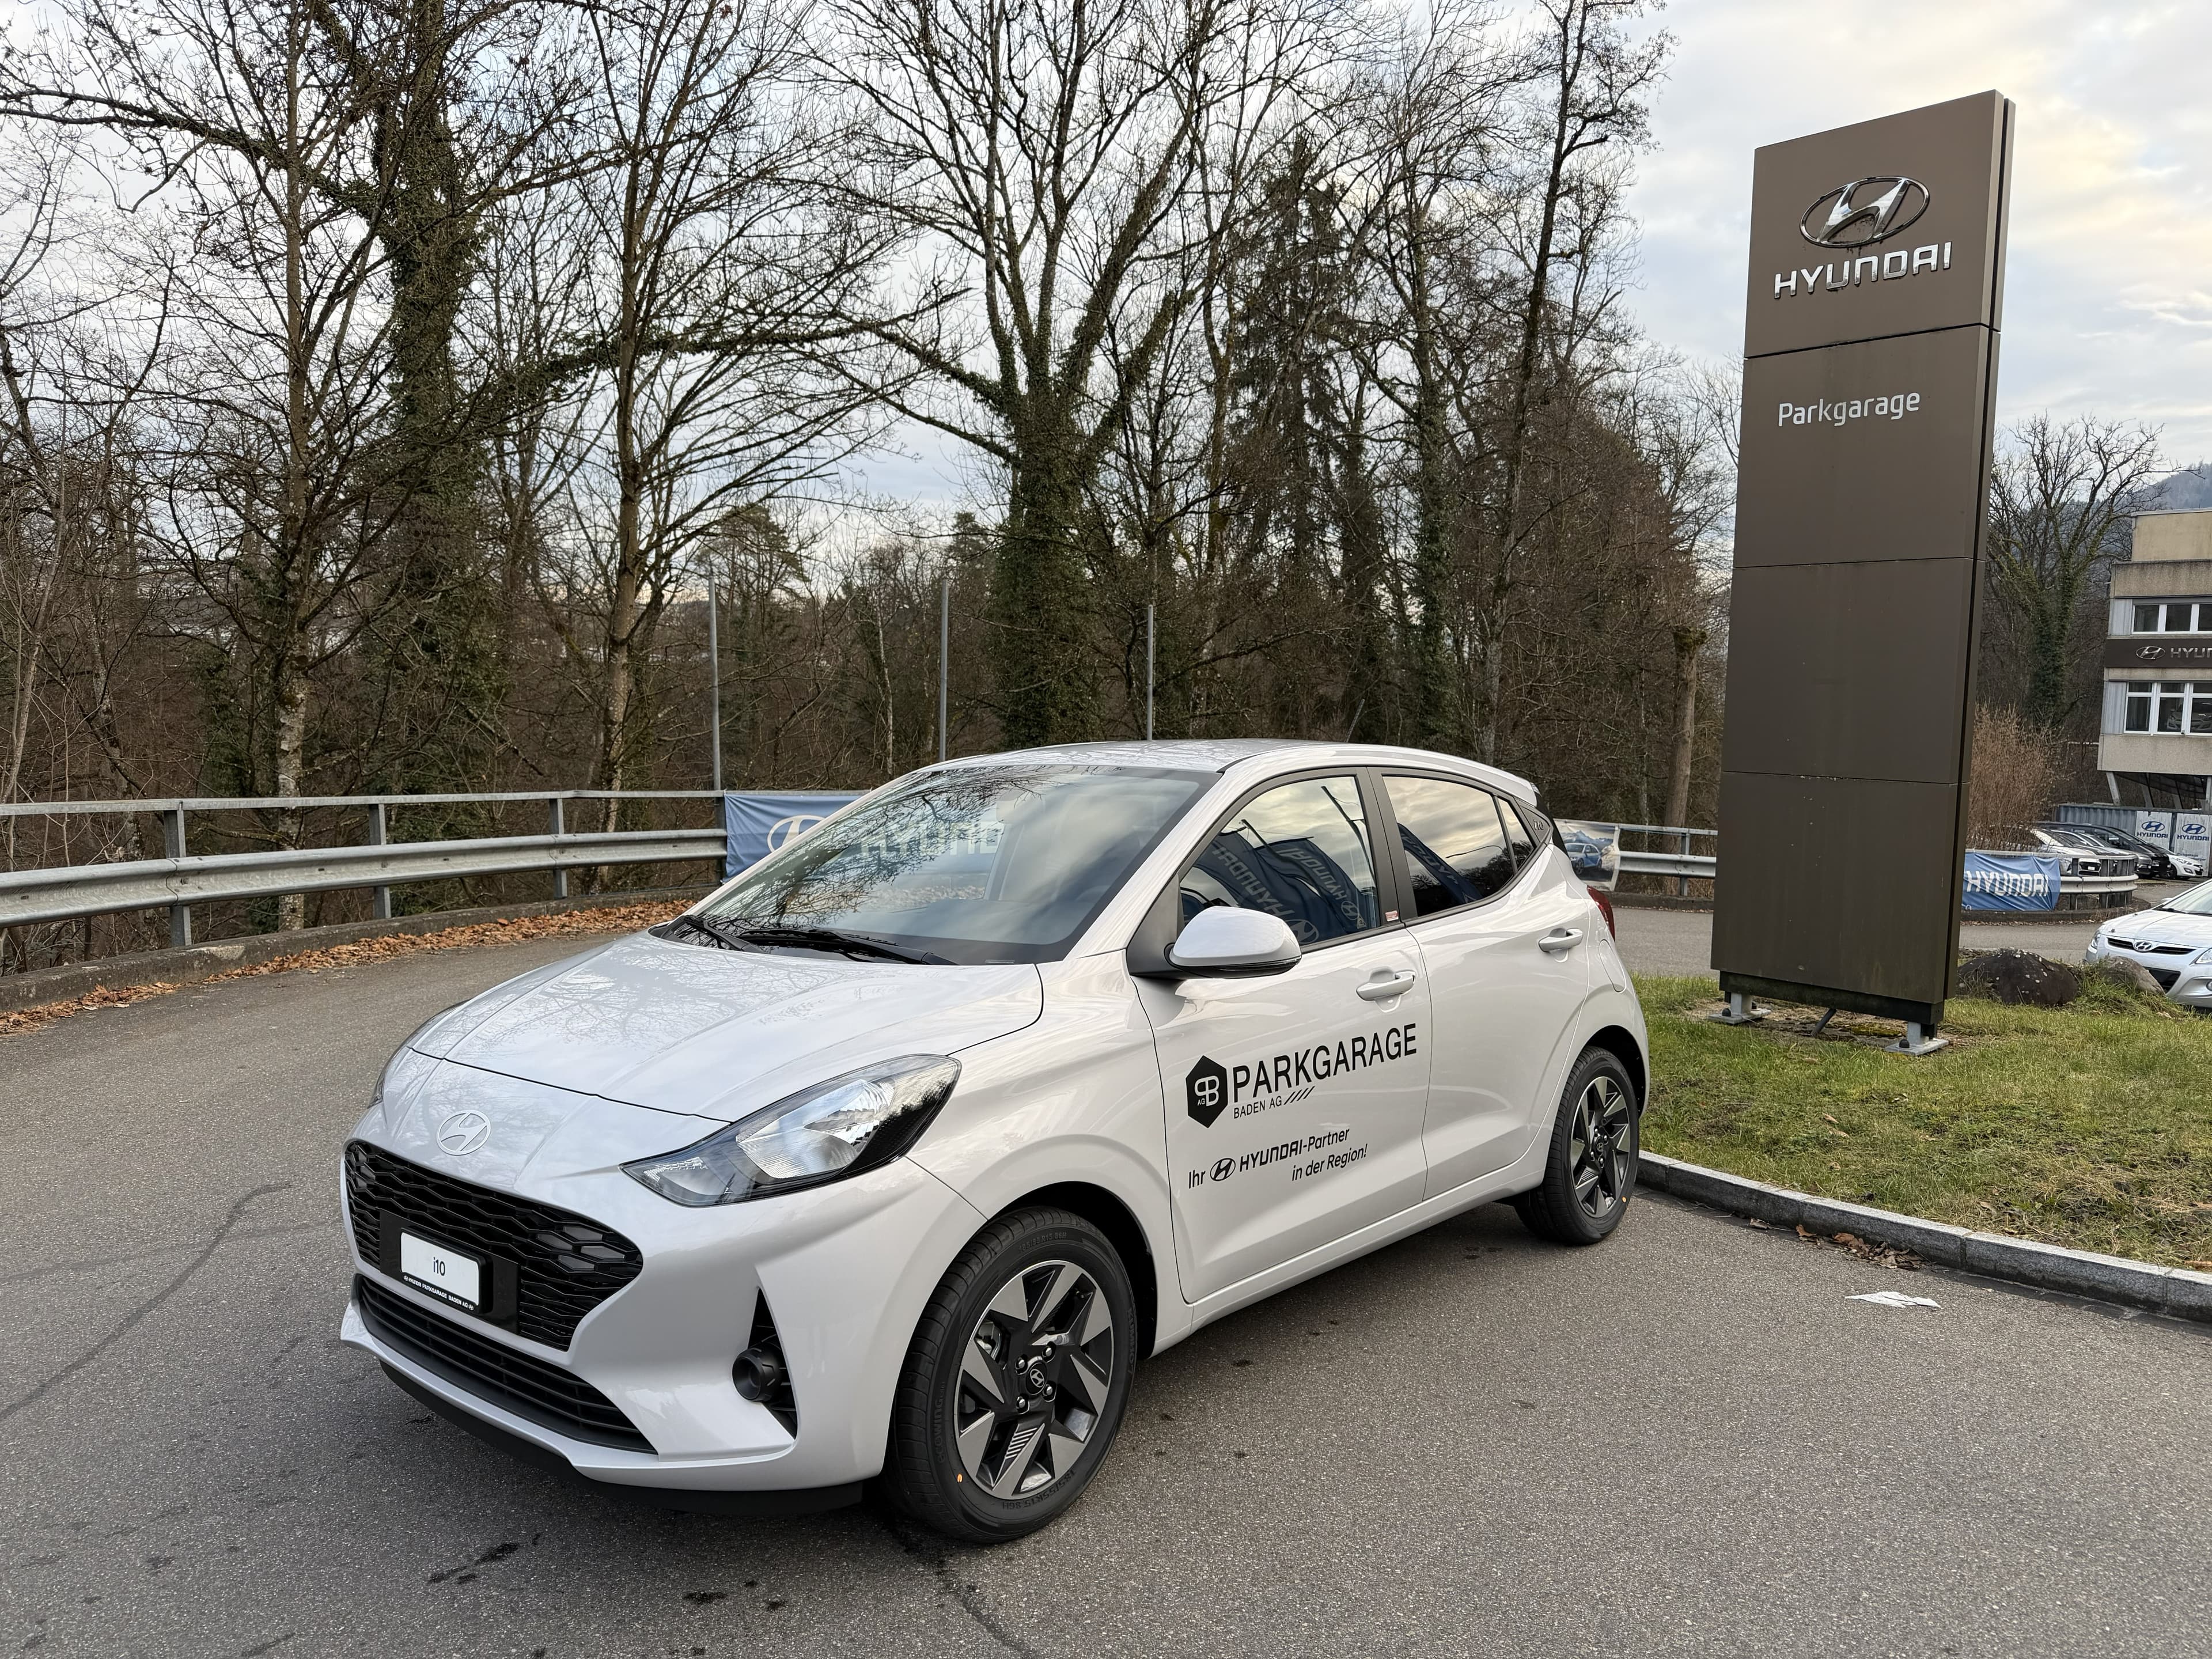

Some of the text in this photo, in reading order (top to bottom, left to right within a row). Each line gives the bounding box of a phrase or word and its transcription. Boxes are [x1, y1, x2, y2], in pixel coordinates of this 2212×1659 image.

[1774, 241, 1952, 299] HYUNDAI
[1778, 392, 1921, 427] Parkgarage
[1533, 819, 1544, 831] i10
[1966, 870, 2049, 897] HYUNDAI
[1232, 1022, 1417, 1103] PARKGARAGE
[1197, 1098, 1206, 1107] AG
[1234, 1095, 1282, 1119] BADEN AG
[1188, 1128, 1350, 1189] Ihr HYUNDAI-Partner
[1291, 1143, 1368, 1181] in der Region!
[433, 1256, 446, 1277] i10
[422, 1283, 448, 1299] PARKGARAGE
[448, 1295, 462, 1305] BADEN
